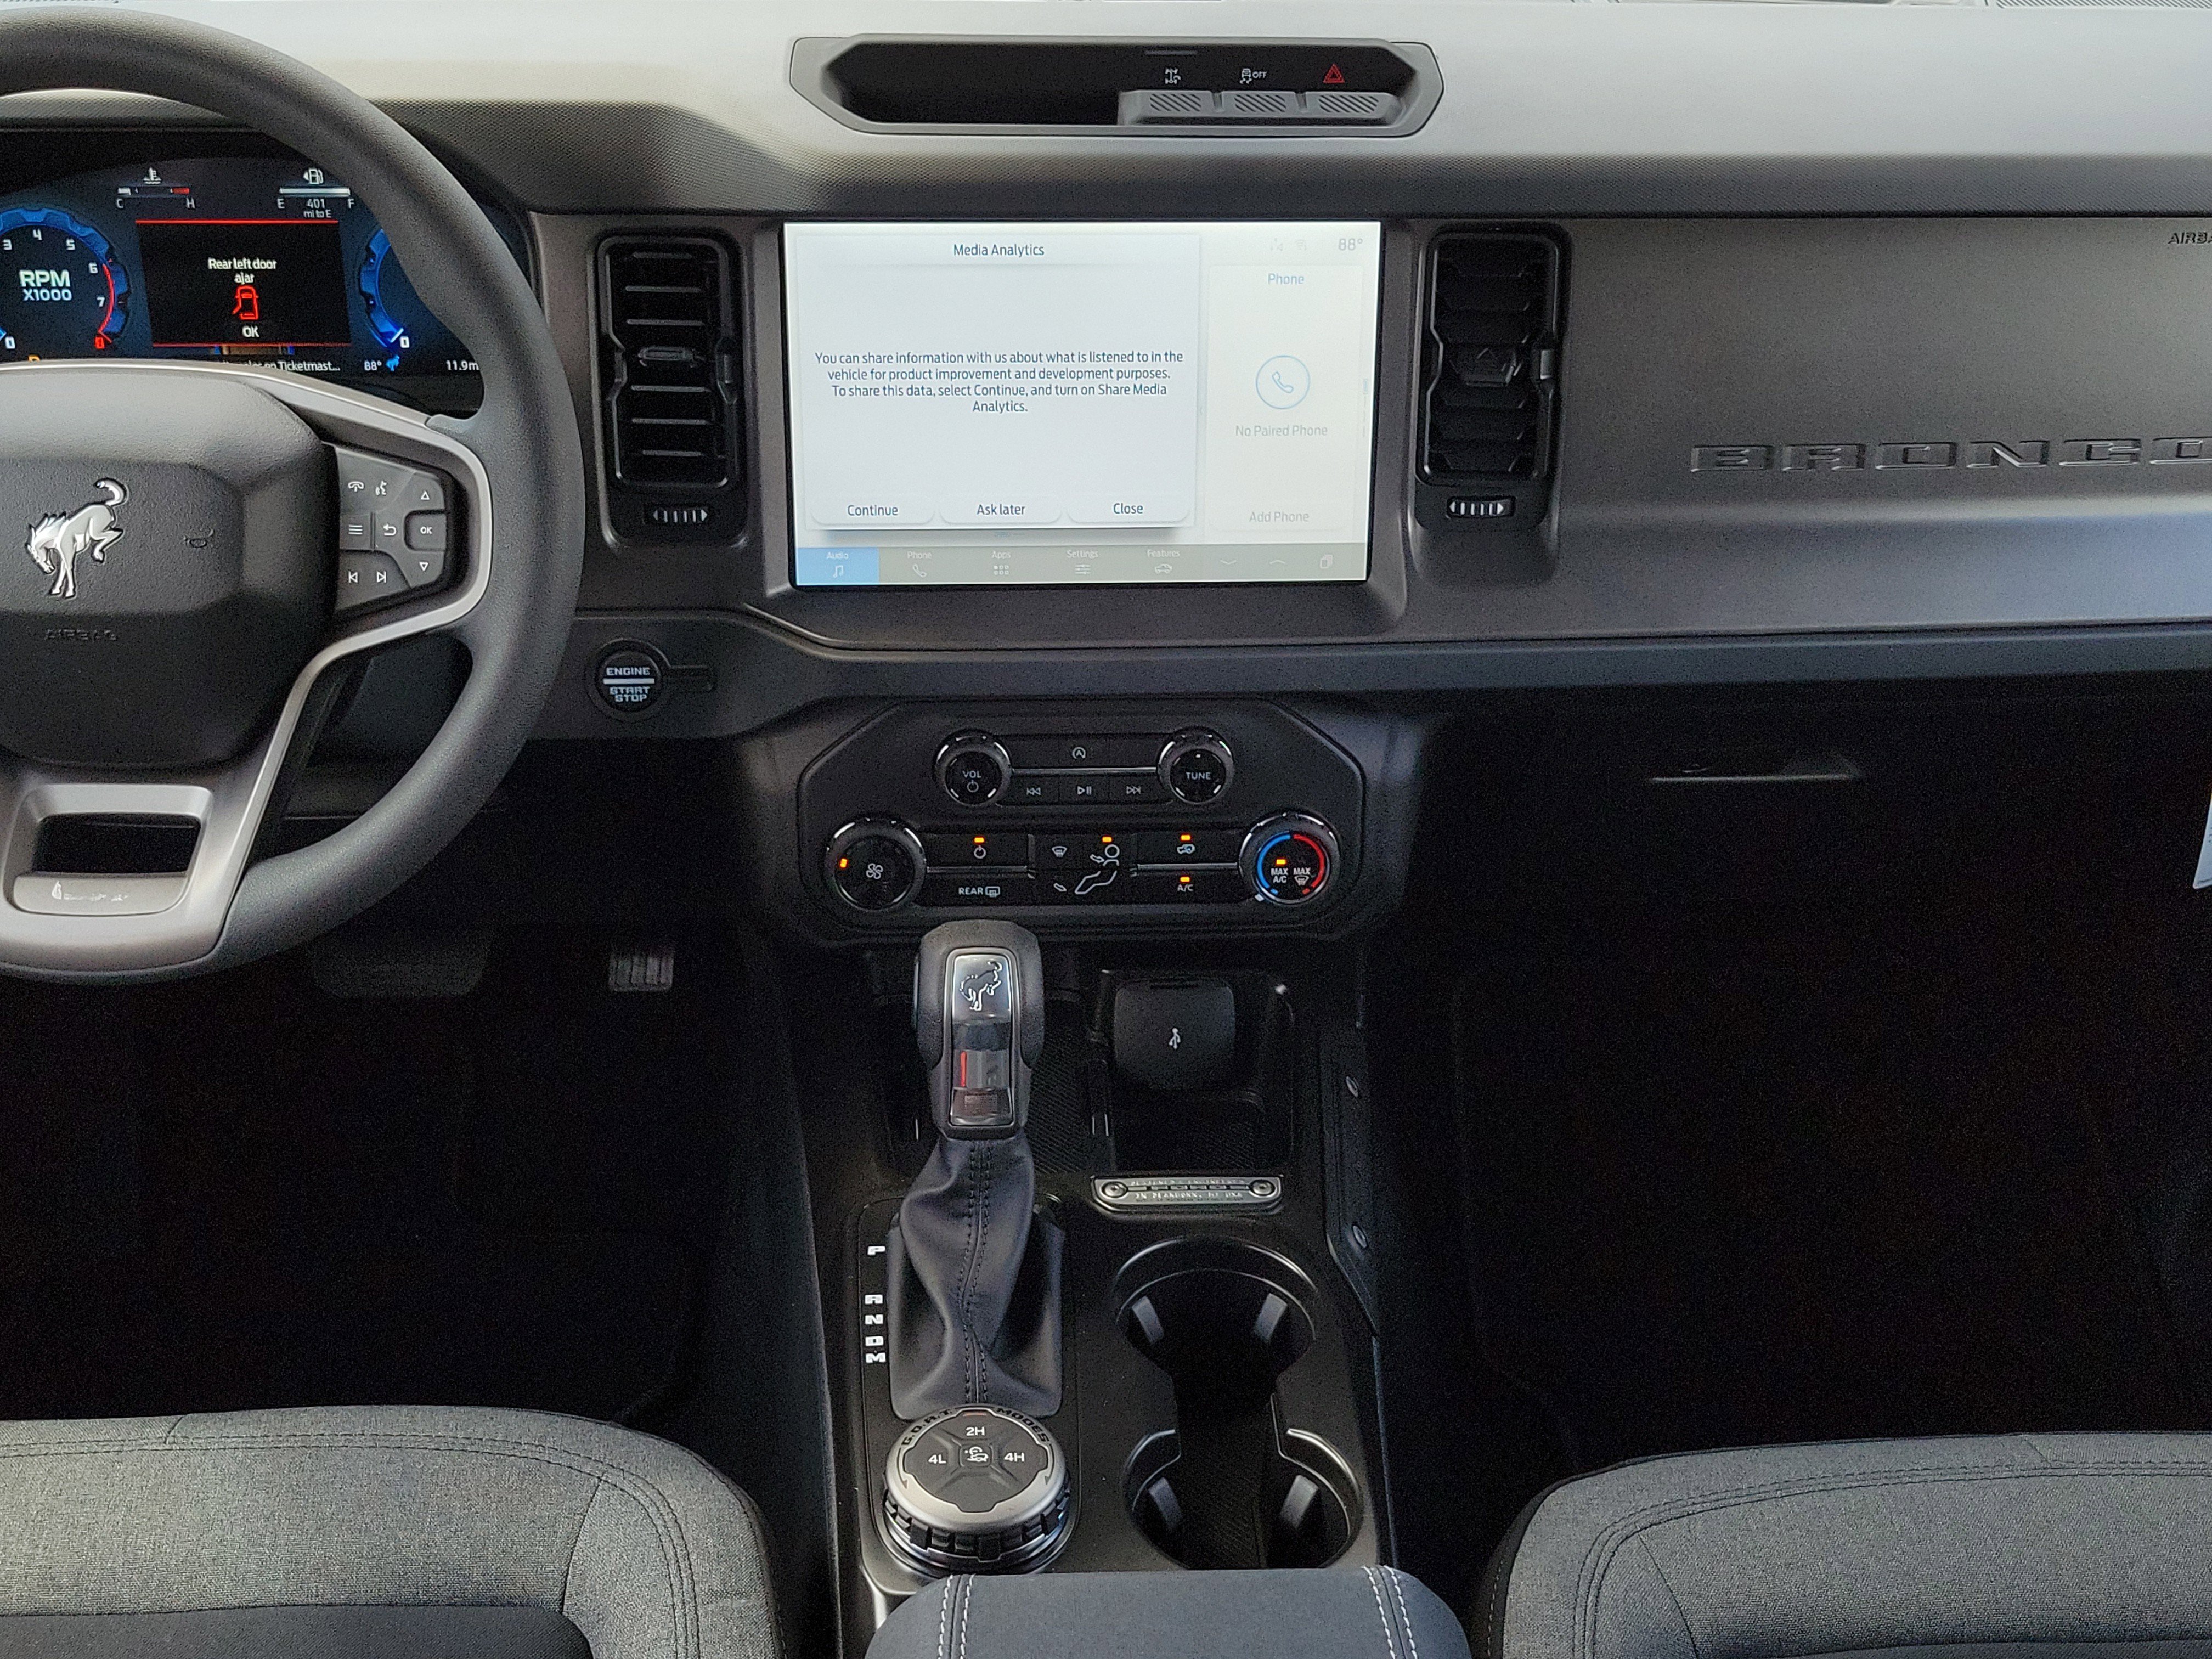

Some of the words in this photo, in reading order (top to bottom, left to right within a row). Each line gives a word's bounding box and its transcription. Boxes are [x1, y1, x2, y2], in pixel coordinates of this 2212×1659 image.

[116, 199, 123, 208] C
[186, 199, 195, 208] H
[277, 199, 284, 208] E
[306, 198, 325, 208] 401
[347, 199, 354, 208] F
[303, 209, 315, 218] mi
[315, 209, 325, 218] to
[325, 209, 332, 218] E
[33, 228, 42, 240] 4
[2, 239, 12, 250] 3
[66, 239, 75, 250] 5
[1339, 238, 1363, 251] 88°
[953, 244, 988, 256] Media
[991, 244, 1045, 258] Analytics
[88, 262, 98, 273] 6
[208, 257, 232, 269] Rear
[233, 257, 252, 269] left
[252, 257, 276, 269] door
[19, 269, 71, 287] RPM
[234, 272, 255, 284] ajar
[1268, 273, 1305, 284] Phone
[22, 289, 72, 301] X1000
[97, 297, 105, 307] 7
[242, 325, 259, 337] OK
[5, 336, 15, 349] 0
[94, 336, 104, 349] 8
[400, 336, 410, 348] 0
[815, 353, 837, 364] You
[840, 354, 859, 363] can
[862, 352, 893, 363] share
[896, 352, 964, 363] information
[967, 352, 992, 363] with
[995, 354, 1007, 363] us
[1010, 352, 1043, 363] about
[1046, 352, 1075, 363] what
[1079, 352, 1087, 362] is
[1090, 351, 1134, 362] listened
[1137, 352, 1149, 362] to
[1152, 352, 1163, 362] in
[1165, 351, 1183, 362] the
[364, 359, 382, 371] 88°
[446, 359, 479, 370] 11.9m
[828, 369, 867, 380] vehicle
[871, 369, 886, 380] for
[889, 368, 934, 382] product
[936, 368, 1012, 381] improvement
[1015, 368, 1036, 379] and
[1039, 367, 1114, 381] development
[1116, 369, 1170, 381] purposes.
[832, 385, 846, 396] To
[849, 385, 879, 396] share
[883, 385, 904, 396] this
[907, 385, 935, 397] data,
[938, 384, 972, 396] select
[974, 385, 1028, 397] Continue,
[1031, 385, 1052, 395] and
[1055, 385, 1078, 395] turn
[1081, 387, 1094, 395] on
[1098, 384, 1131, 395] Share
[1133, 383, 1167, 394] Media
[973, 400, 1028, 413] Analytics.
[1235, 426, 1251, 436] No
[1254, 425, 1289, 436] Paired
[1292, 425, 1328, 436] Phone
[1691, 437, 2212, 473] BRONCO
[848, 504, 898, 516] Continue
[977, 504, 997, 516] Ask
[1000, 504, 1025, 516] later
[1114, 503, 1143, 515] Close
[1249, 511, 1271, 522] Add
[1274, 511, 1310, 522] Phone
[420, 526, 432, 534] OK
[826, 551, 849, 560] Audio
[907, 551, 933, 559] Phone
[992, 551, 1011, 560] Apps
[1066, 550, 1099, 559] Settings
[1147, 549, 1181, 558] Features
[606, 667, 650, 676] ENGINE
[610, 686, 650, 695] START
[963, 770, 982, 778] VOL
[1186, 772, 1211, 780] TUNE
[958, 887, 984, 895] REAR
[867, 1246, 885, 1255] P
[865, 1314, 884, 1324] N
[865, 1336, 884, 1346] D
[866, 1352, 886, 1363] M
[966, 1426, 985, 1436] 2H
[996, 1408, 1050, 1443] MODES
[928, 1454, 947, 1464] 4L
[1004, 1452, 1025, 1462] 4H
